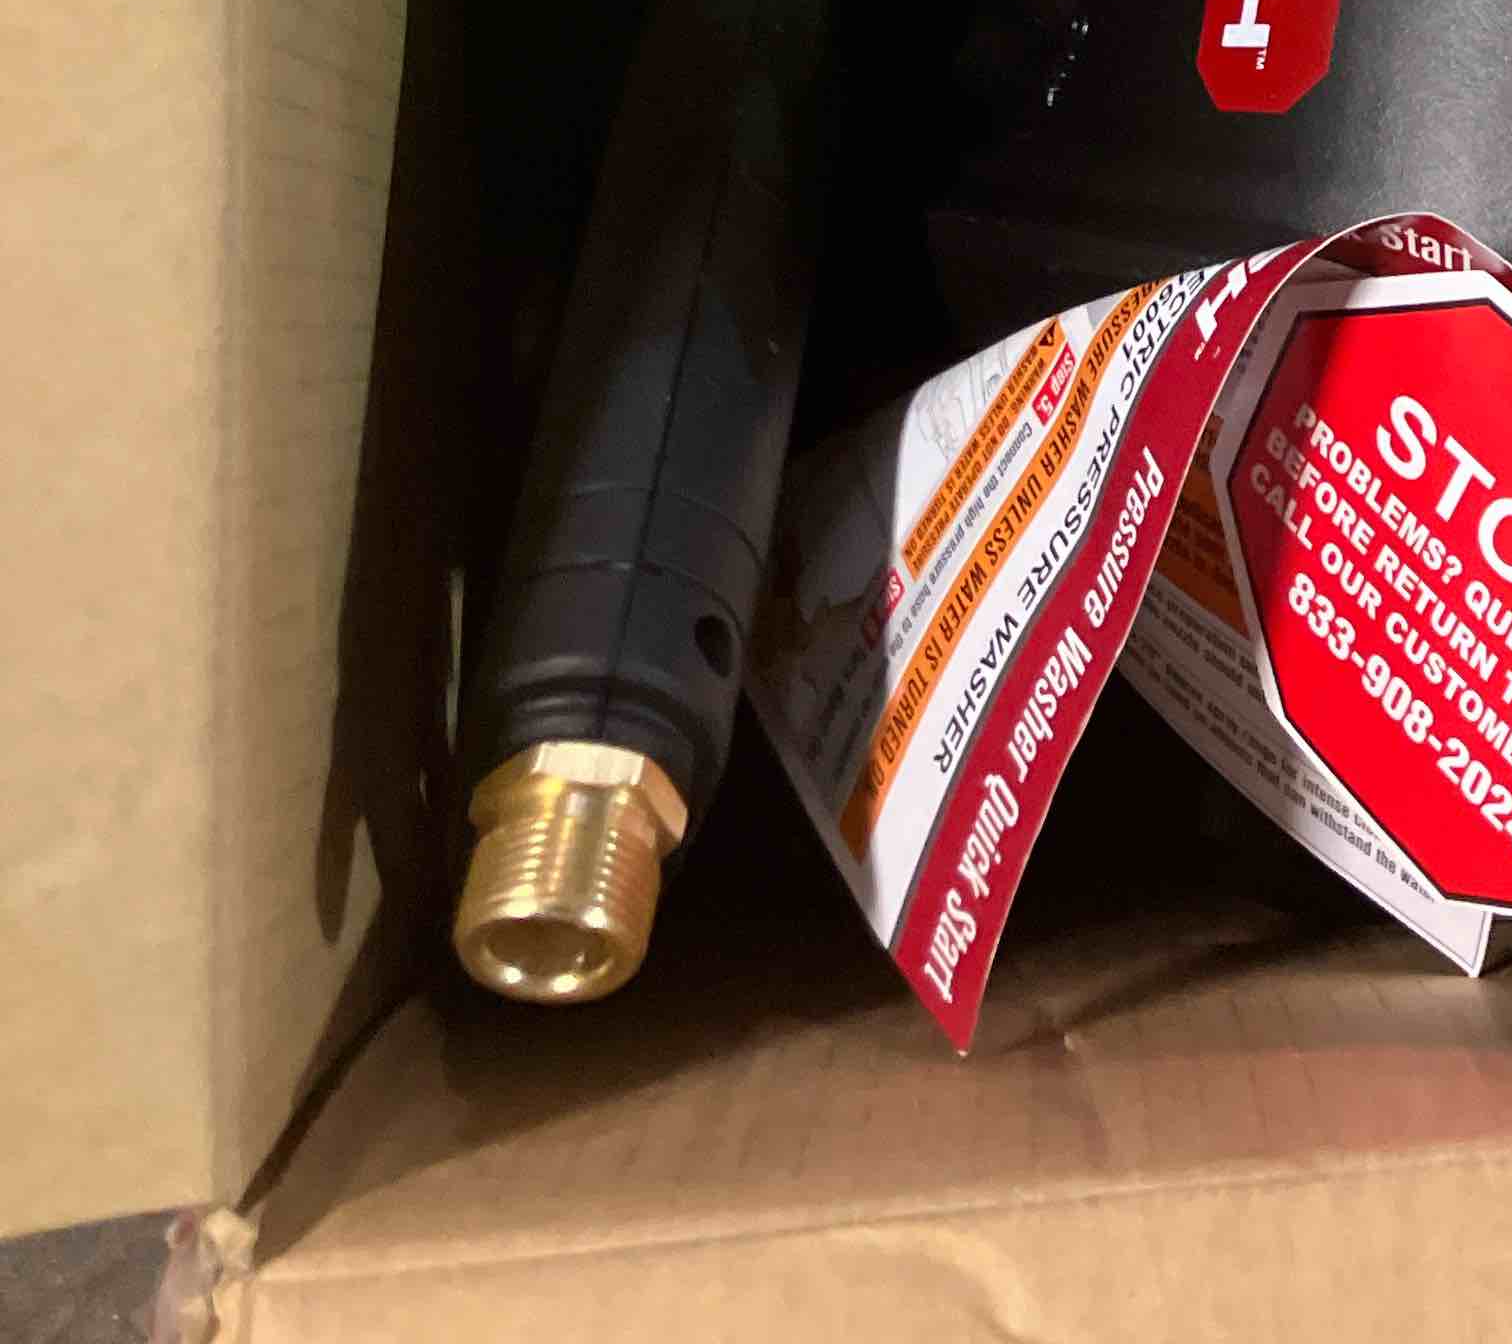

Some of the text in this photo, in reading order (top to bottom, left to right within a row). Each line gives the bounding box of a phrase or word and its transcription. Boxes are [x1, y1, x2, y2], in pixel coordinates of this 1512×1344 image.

[1379, 221, 1473, 272] Start
[1049, 350, 1077, 396] Step
[996, 419, 1034, 478] Connect
[1040, 379, 1092, 477] WASHER
[962, 492, 987, 530] high
[982, 471, 1000, 499] the
[984, 472, 1044, 566] UNLESS
[1016, 411, 1120, 608] PRESSURE
[1295, 402, 1463, 584] PROBLEMS?
[927, 525, 966, 587] pressure
[1250, 462, 1314, 551] CALL
[1320, 542, 1383, 621] OUR
[1265, 426, 1376, 555] BEFORE
[1374, 543, 1499, 682] RETURN
[938, 561, 988, 643] WATER
[924, 636, 944, 673] IS
[933, 611, 1019, 775] WASHER
[880, 665, 930, 765] TURNED
[924, 447, 1165, 1004] Pressure Washer Quick Start
[1301, 776, 1351, 819] intense
[1309, 802, 1374, 858] withstand
[1375, 848, 1398, 875] the
